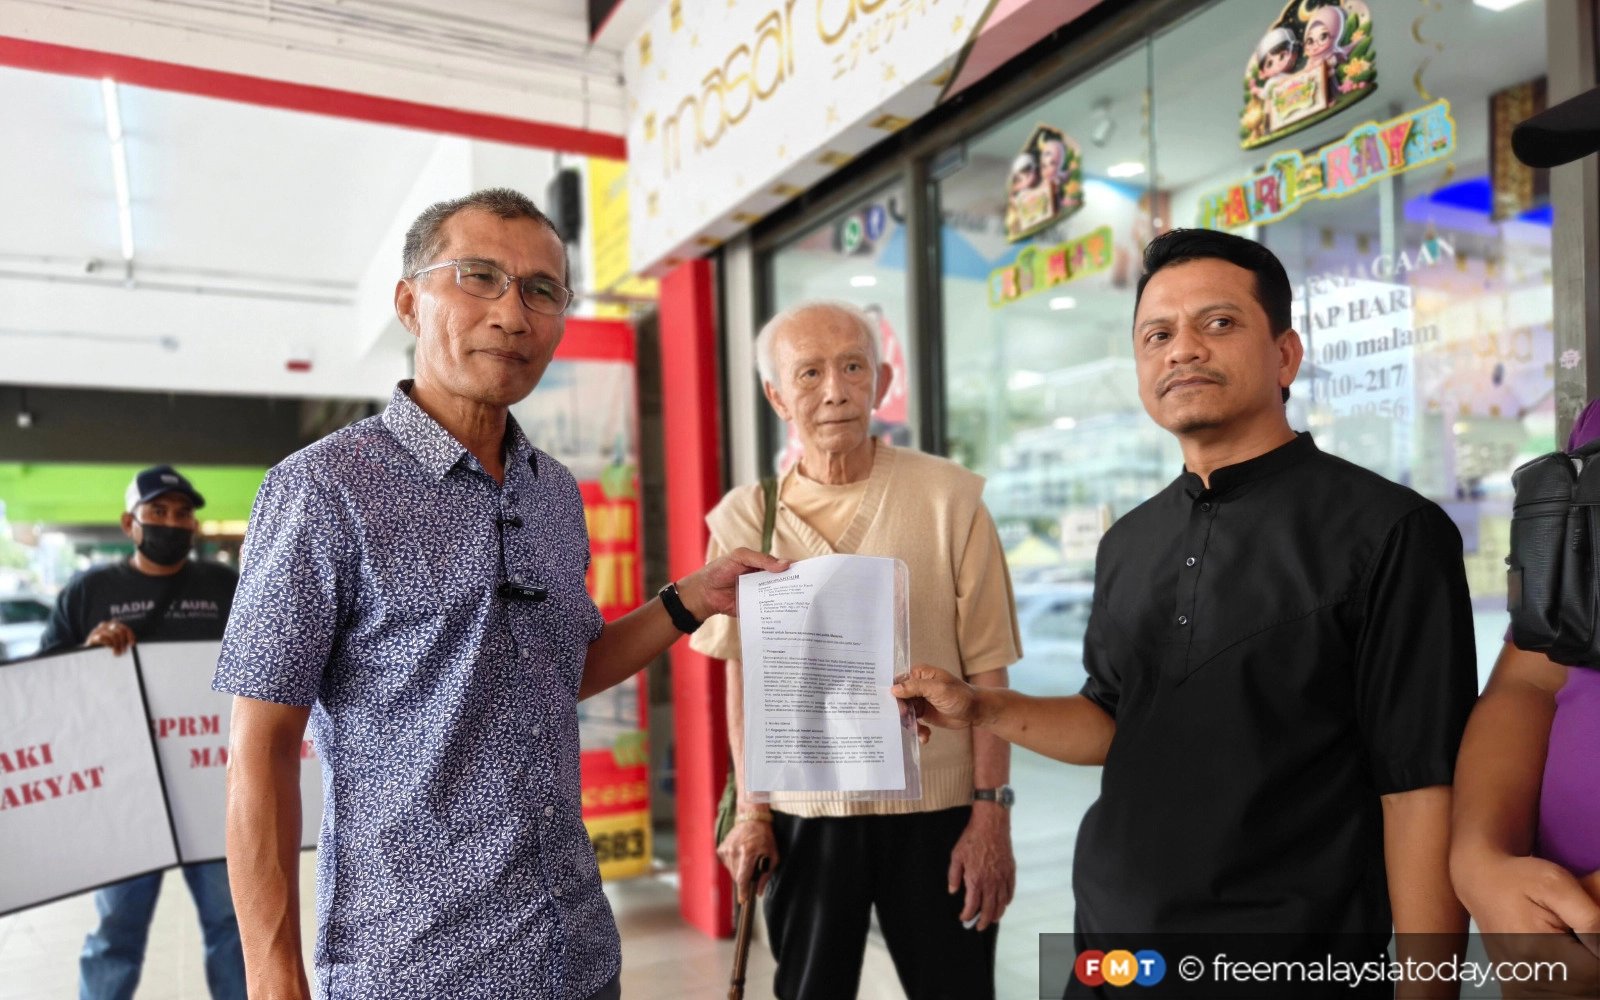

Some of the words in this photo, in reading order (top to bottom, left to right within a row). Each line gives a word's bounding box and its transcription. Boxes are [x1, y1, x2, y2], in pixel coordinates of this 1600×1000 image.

[662, 0, 797, 179] masar
[1356, 325, 1439, 357] malam
[180, 599, 219, 611] AURA
[152, 714, 221, 739] PRM
[189, 745, 231, 769] MA
